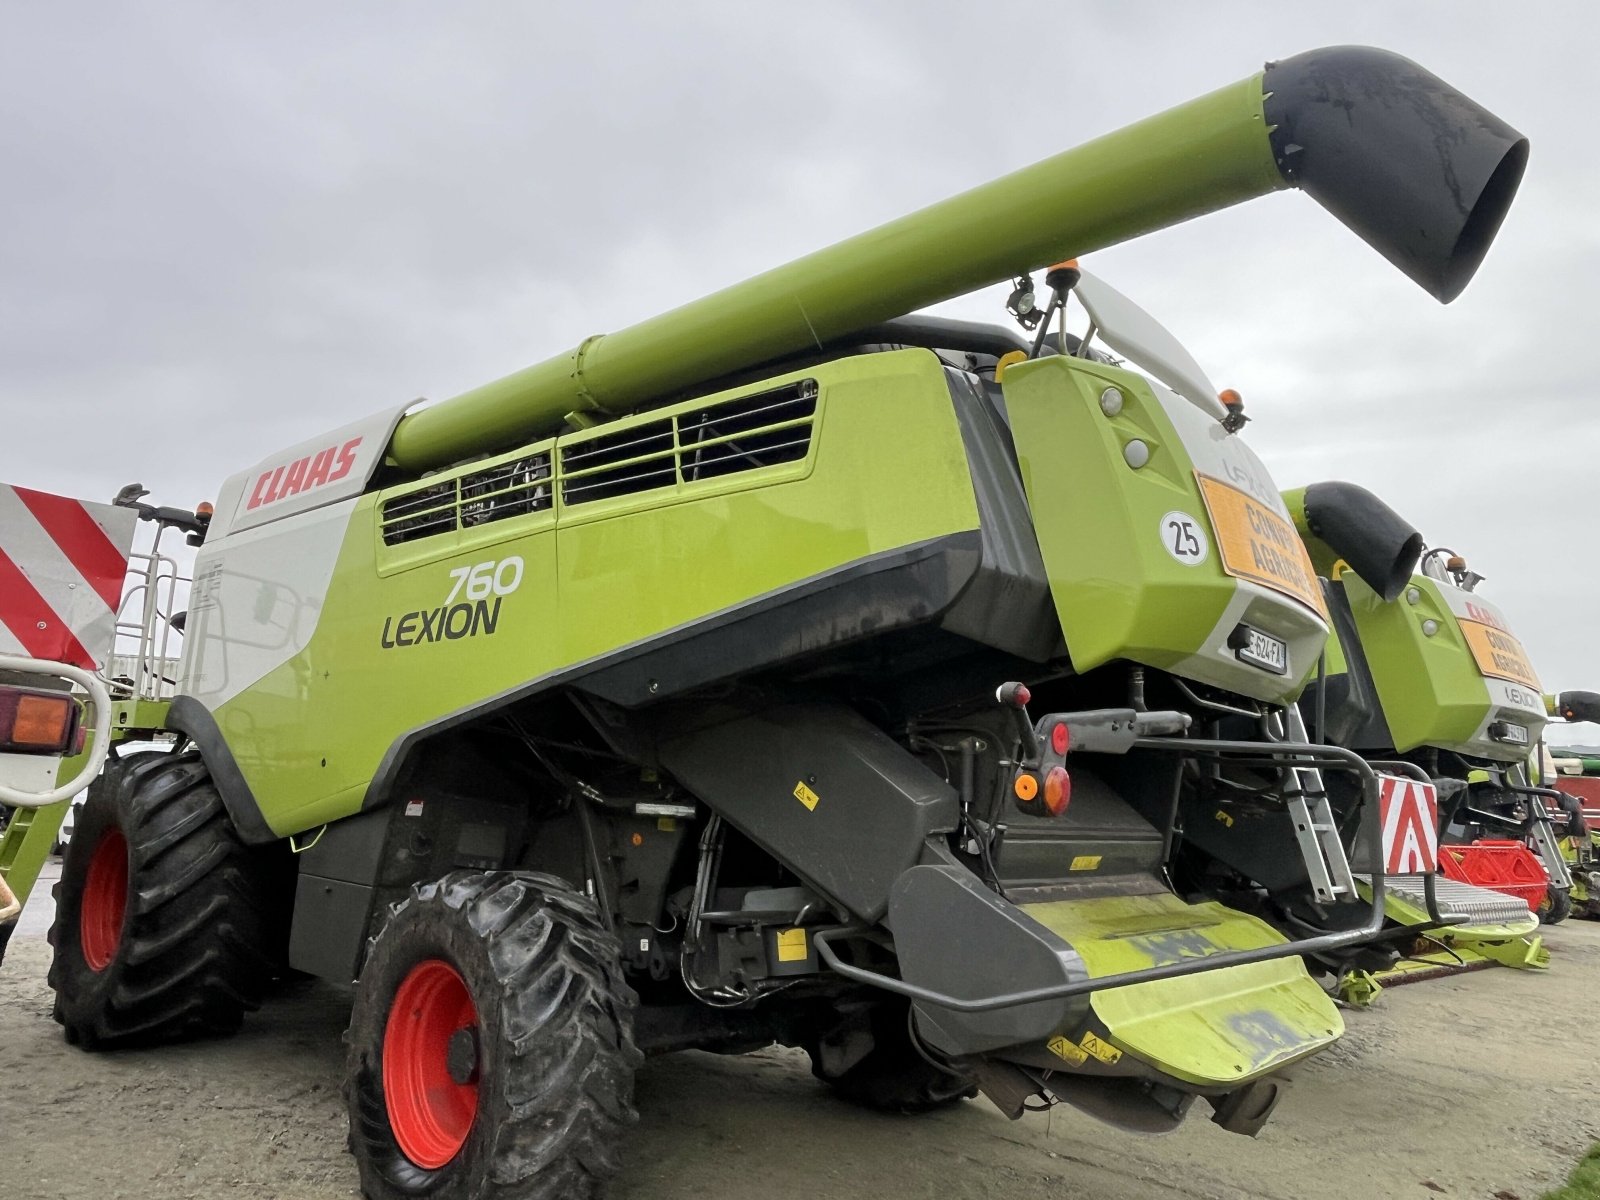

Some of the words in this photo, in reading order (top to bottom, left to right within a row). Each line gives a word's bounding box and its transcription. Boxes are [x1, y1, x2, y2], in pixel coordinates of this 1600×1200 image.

[247, 436, 363, 510] CLAAS
[1168, 521, 1200, 556] 25
[444, 556, 524, 606] 760
[382, 597, 502, 648] LEXION
